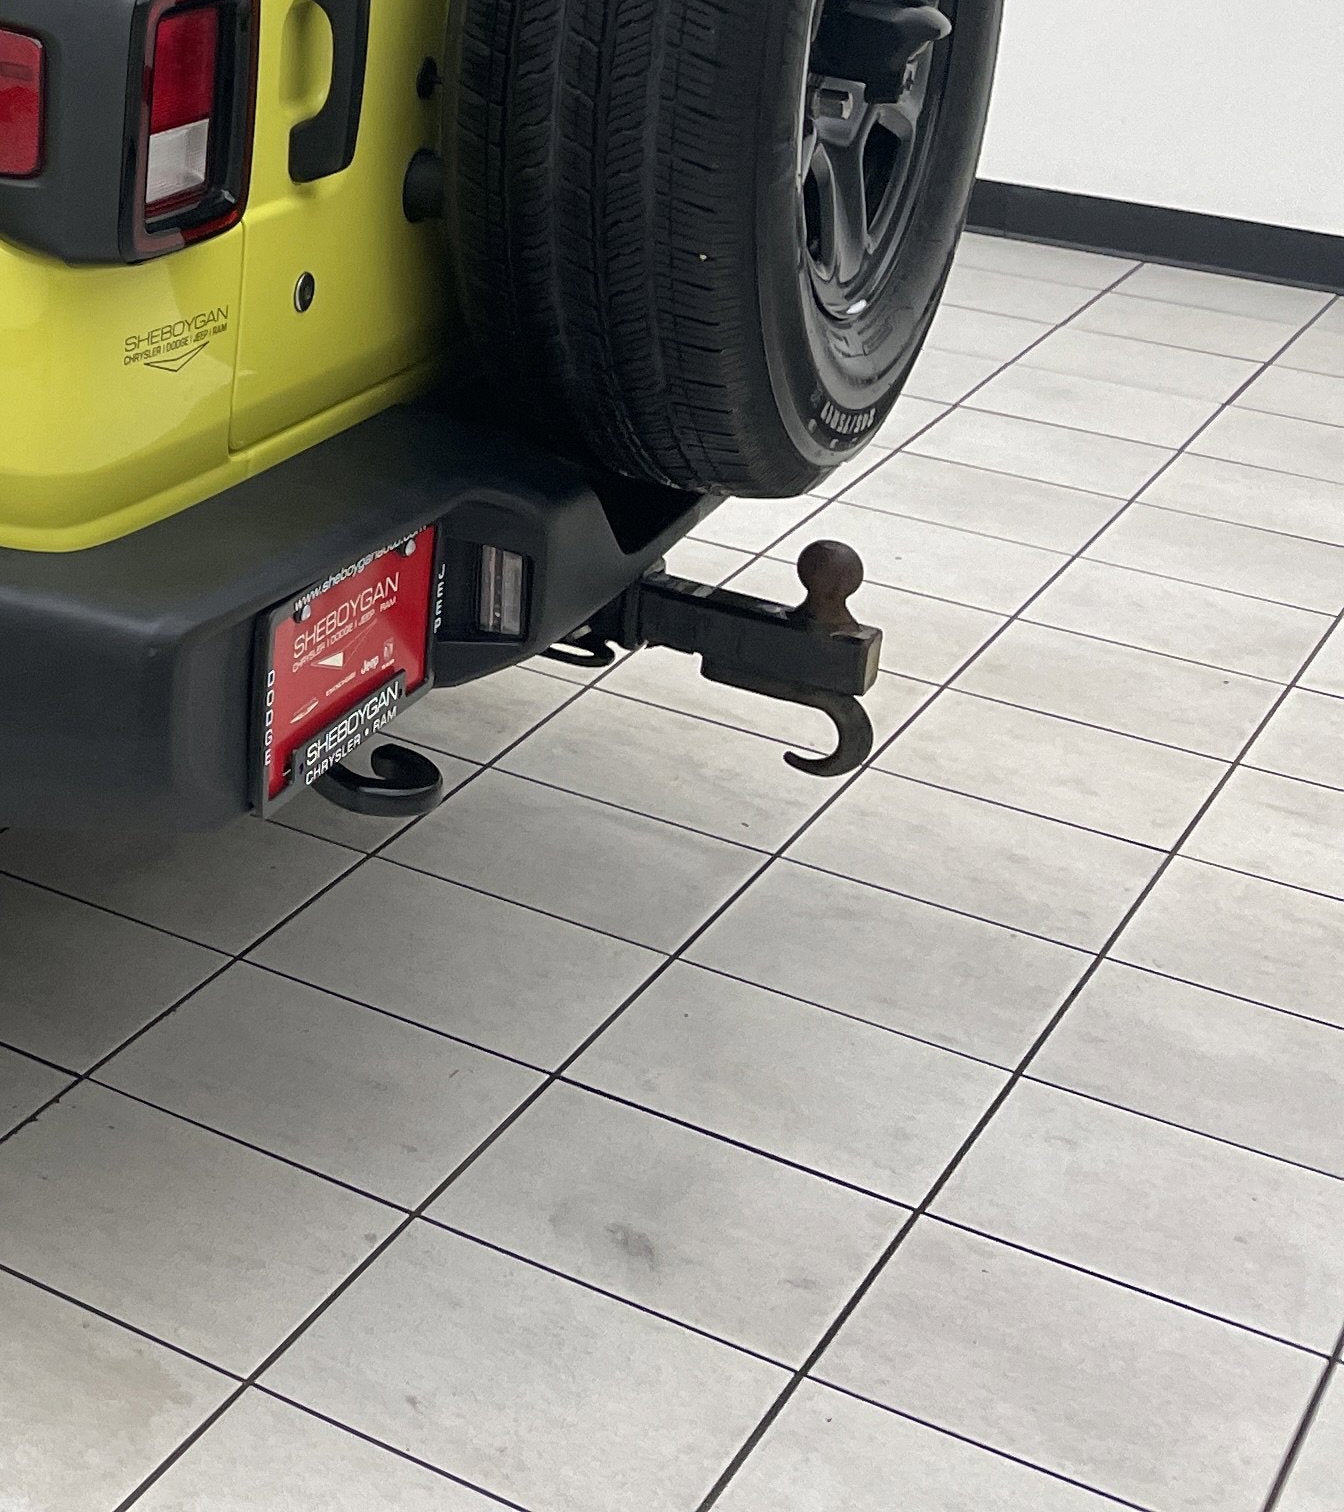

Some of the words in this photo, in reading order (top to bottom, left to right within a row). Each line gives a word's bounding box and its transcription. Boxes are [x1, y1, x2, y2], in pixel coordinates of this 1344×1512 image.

[123, 345, 161, 366] CHRYSLER
[124, 304, 229, 353] SHEBOYGAN
[293, 571, 400, 659] SHEBOYGAN
[433, 563, 446, 634] JEEP
[265, 669, 276, 766] DODGE
[305, 733, 361, 786] CHRYSLER
[373, 705, 397, 733] RAM
[306, 680, 399, 766] SHEBOYGAN
